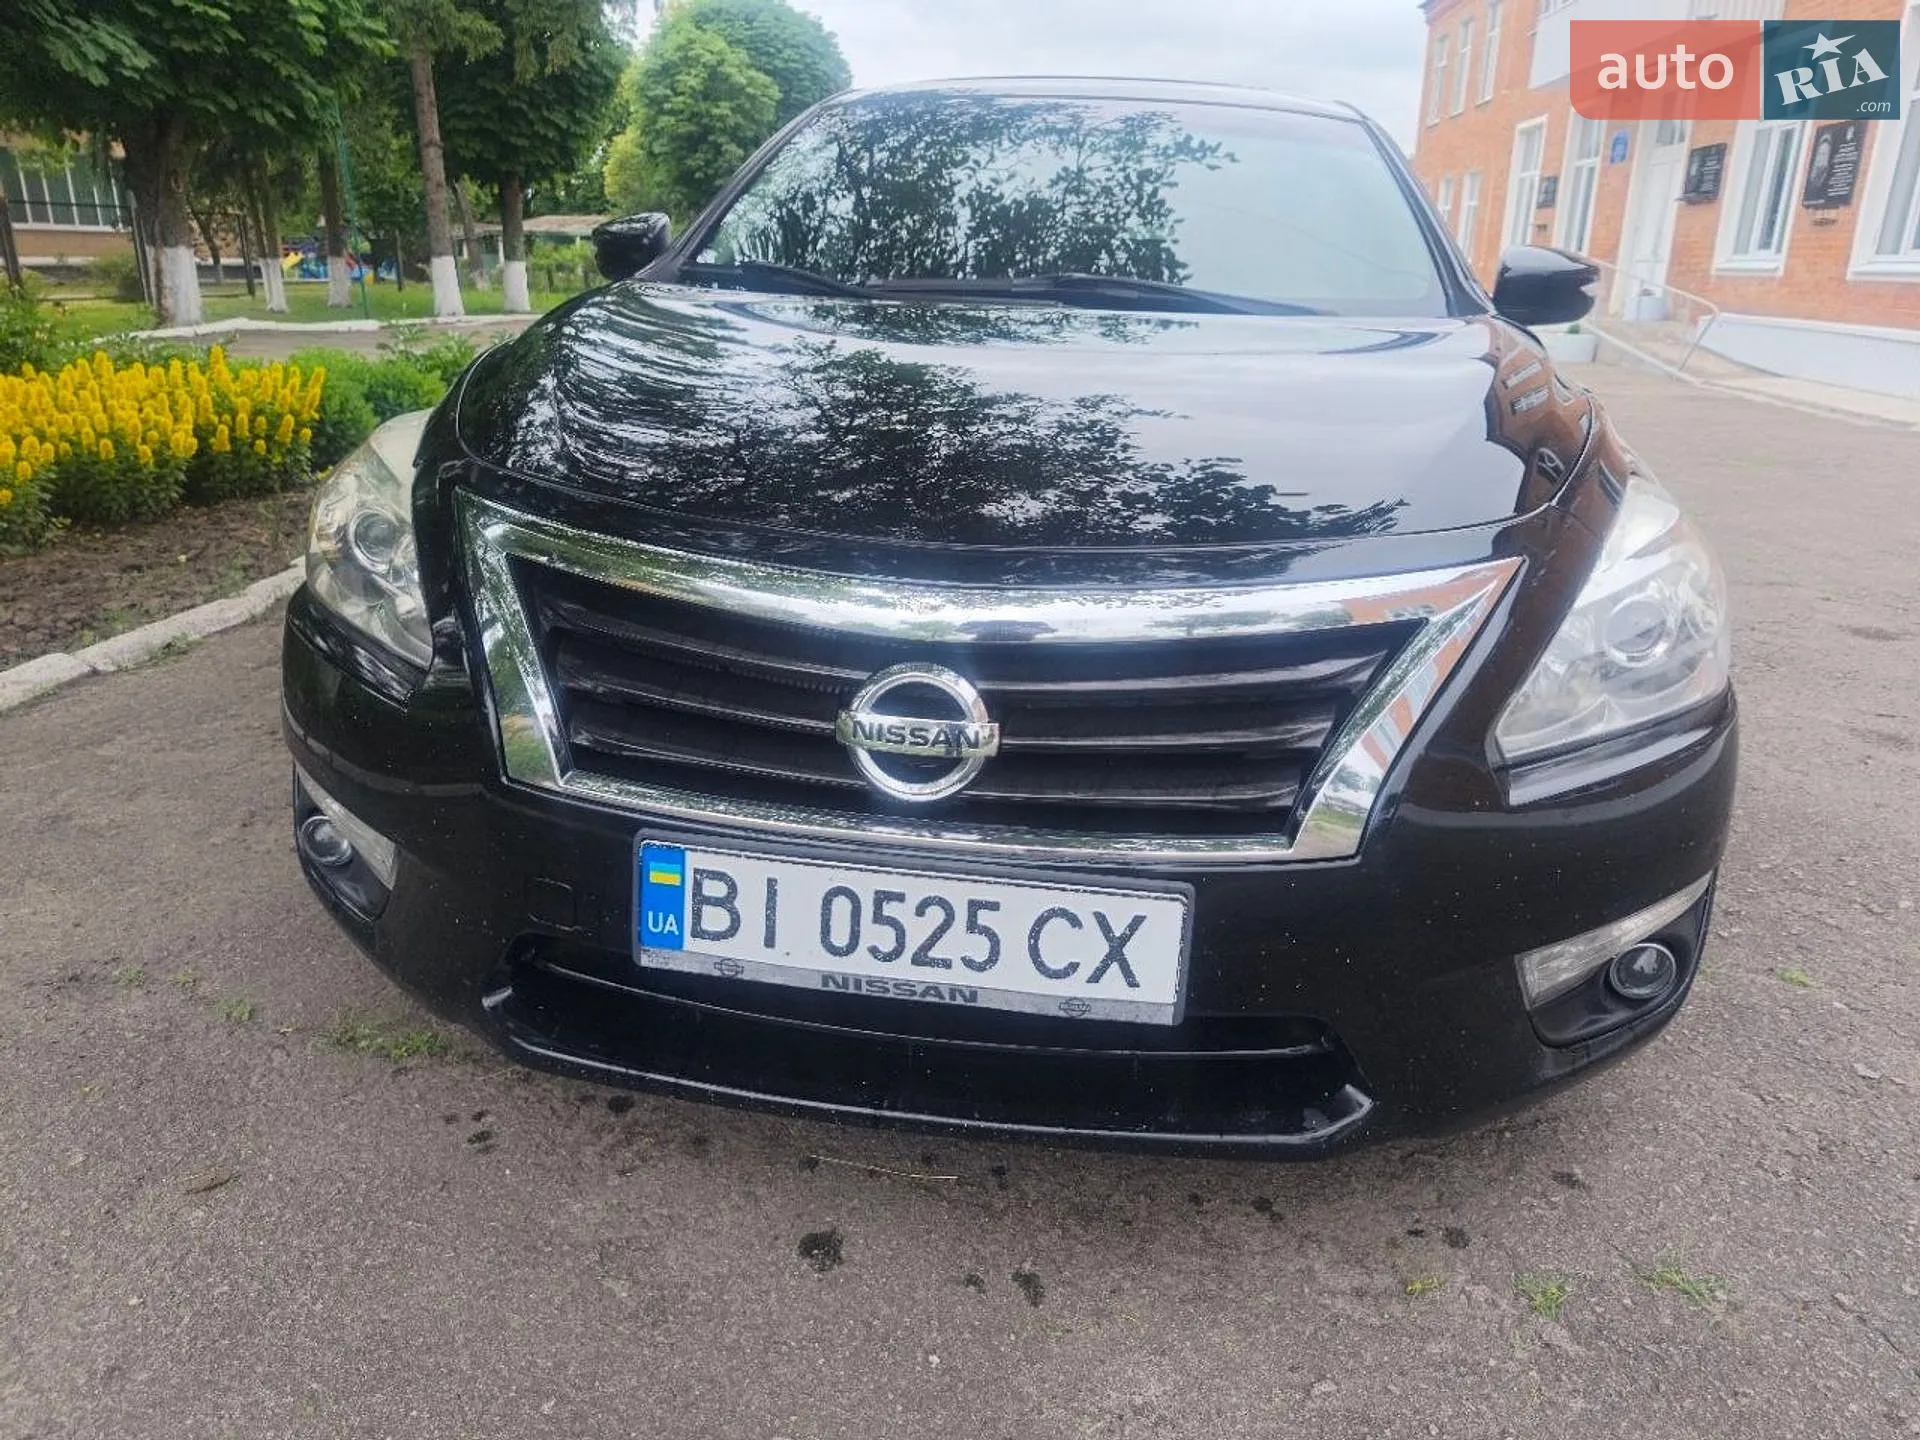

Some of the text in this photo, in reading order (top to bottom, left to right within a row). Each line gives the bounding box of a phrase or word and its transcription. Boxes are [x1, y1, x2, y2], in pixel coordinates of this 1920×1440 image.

[852, 719, 980, 750] NISSAN
[647, 911, 679, 936] UA
[690, 867, 1148, 989] BI 0525 CX
[820, 973, 979, 1004] NISSAN
